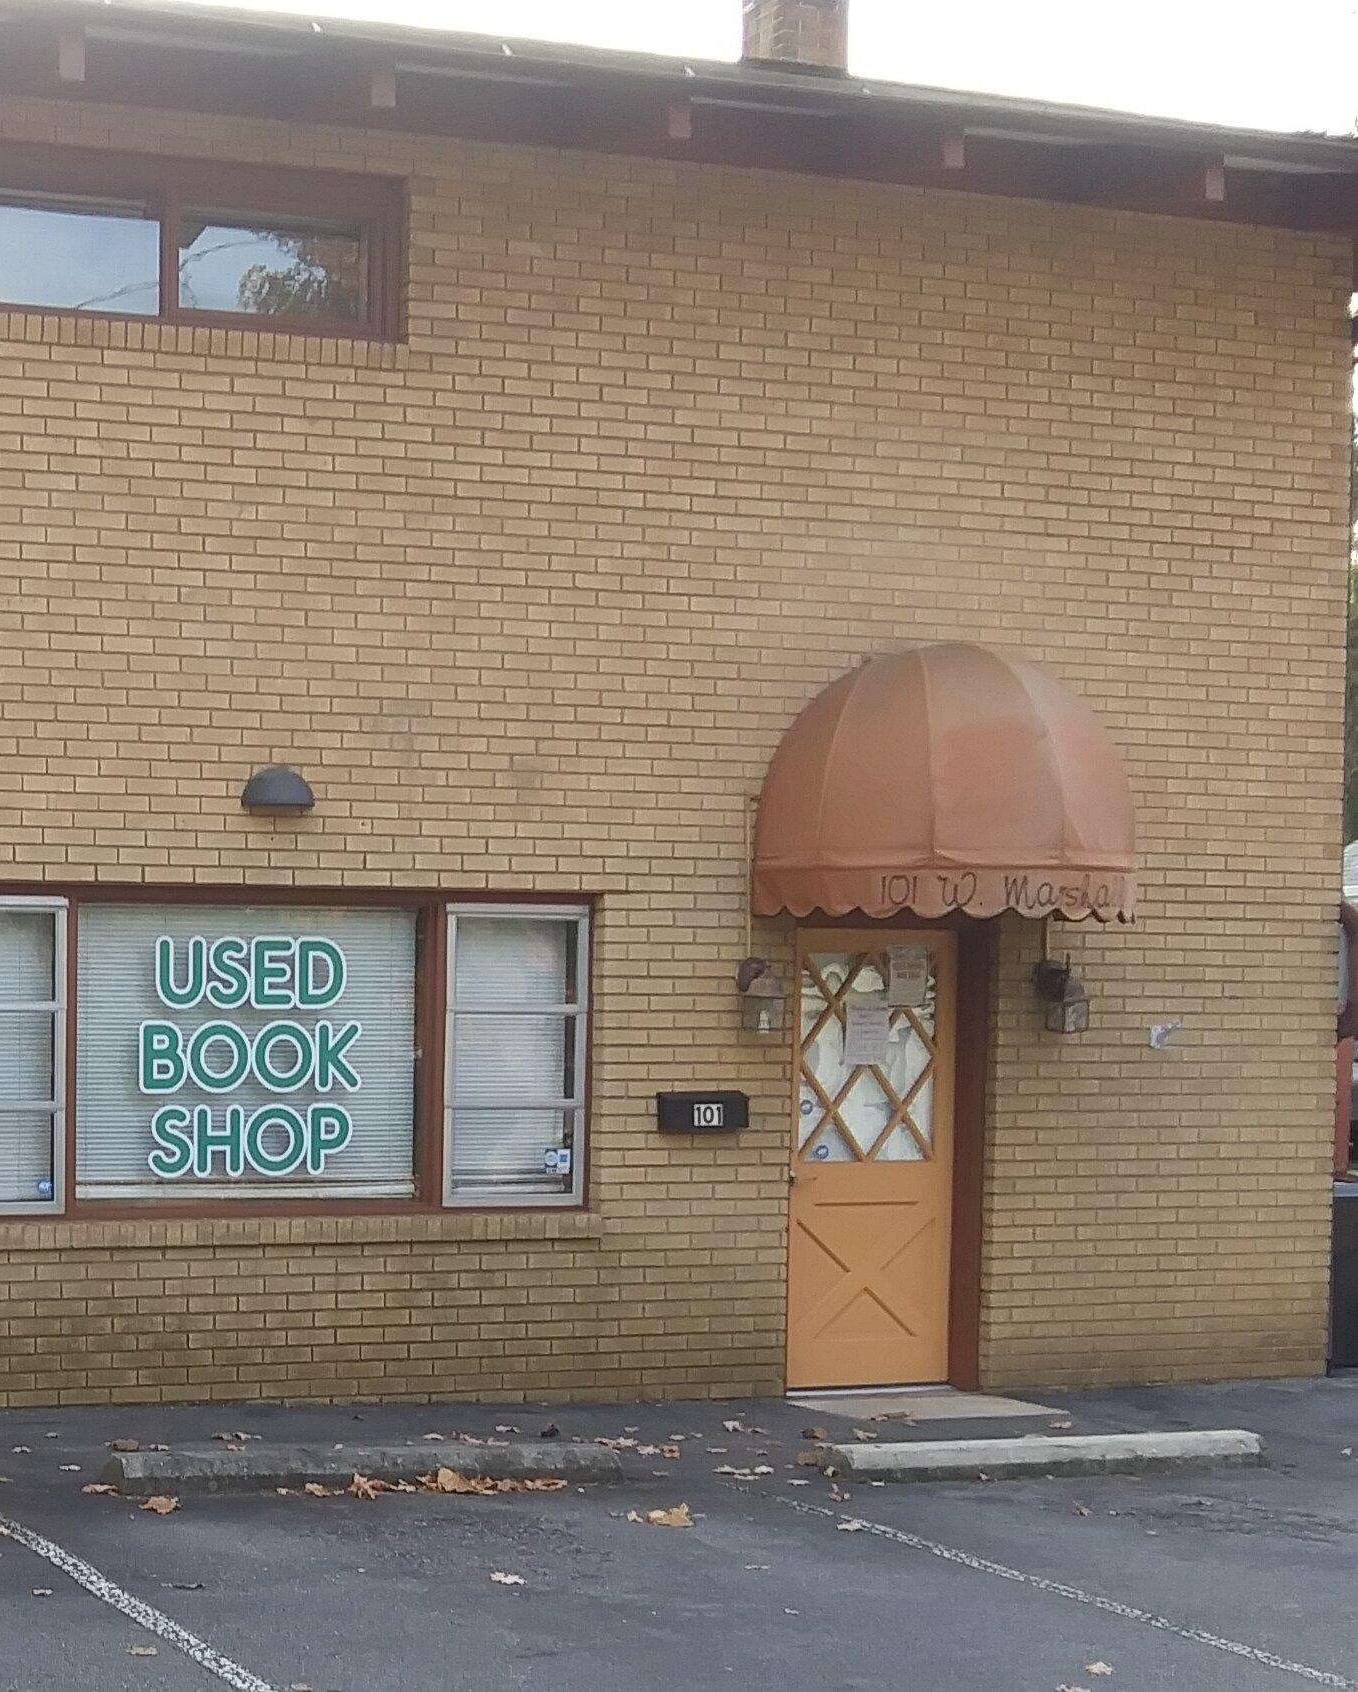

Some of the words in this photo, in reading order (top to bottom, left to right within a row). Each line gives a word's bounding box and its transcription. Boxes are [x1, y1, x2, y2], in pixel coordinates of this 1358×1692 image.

[882, 874, 918, 905] 101
[937, 871, 983, 907] W.
[157, 937, 345, 1008] USED
[141, 1021, 360, 1093] BOOK
[149, 1105, 351, 1176] SHOP
[695, 1105, 722, 1125] 101
